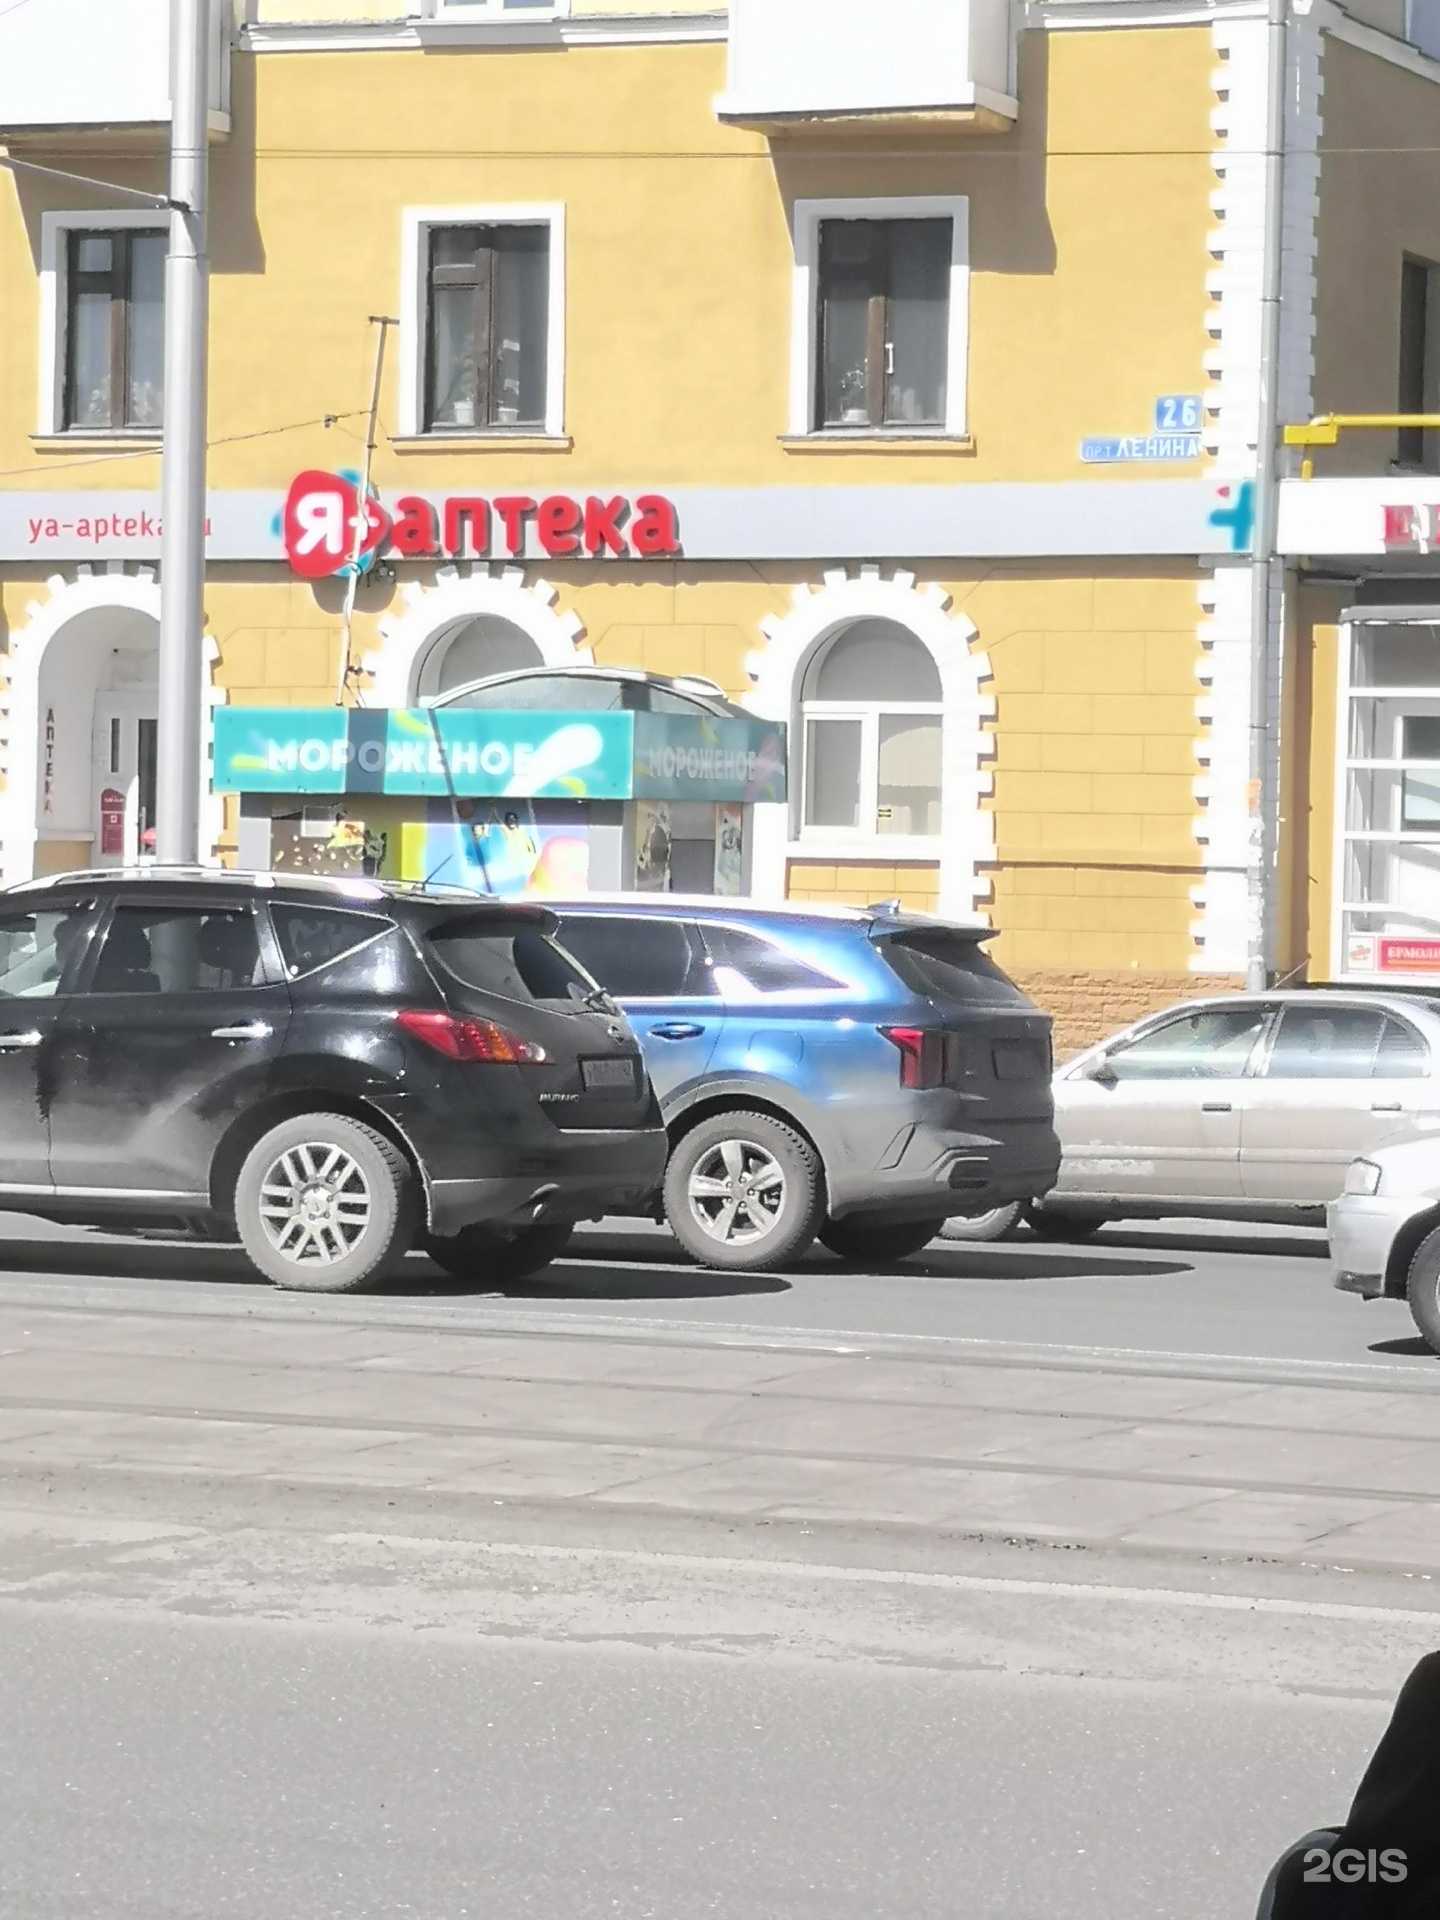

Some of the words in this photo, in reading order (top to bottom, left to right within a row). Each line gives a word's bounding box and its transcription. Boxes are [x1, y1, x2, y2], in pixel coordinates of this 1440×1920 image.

[1162, 399, 1196, 427] 26
[1116, 437, 1198, 458] ЛЕНИНА
[391, 494, 681, 555] аптека
